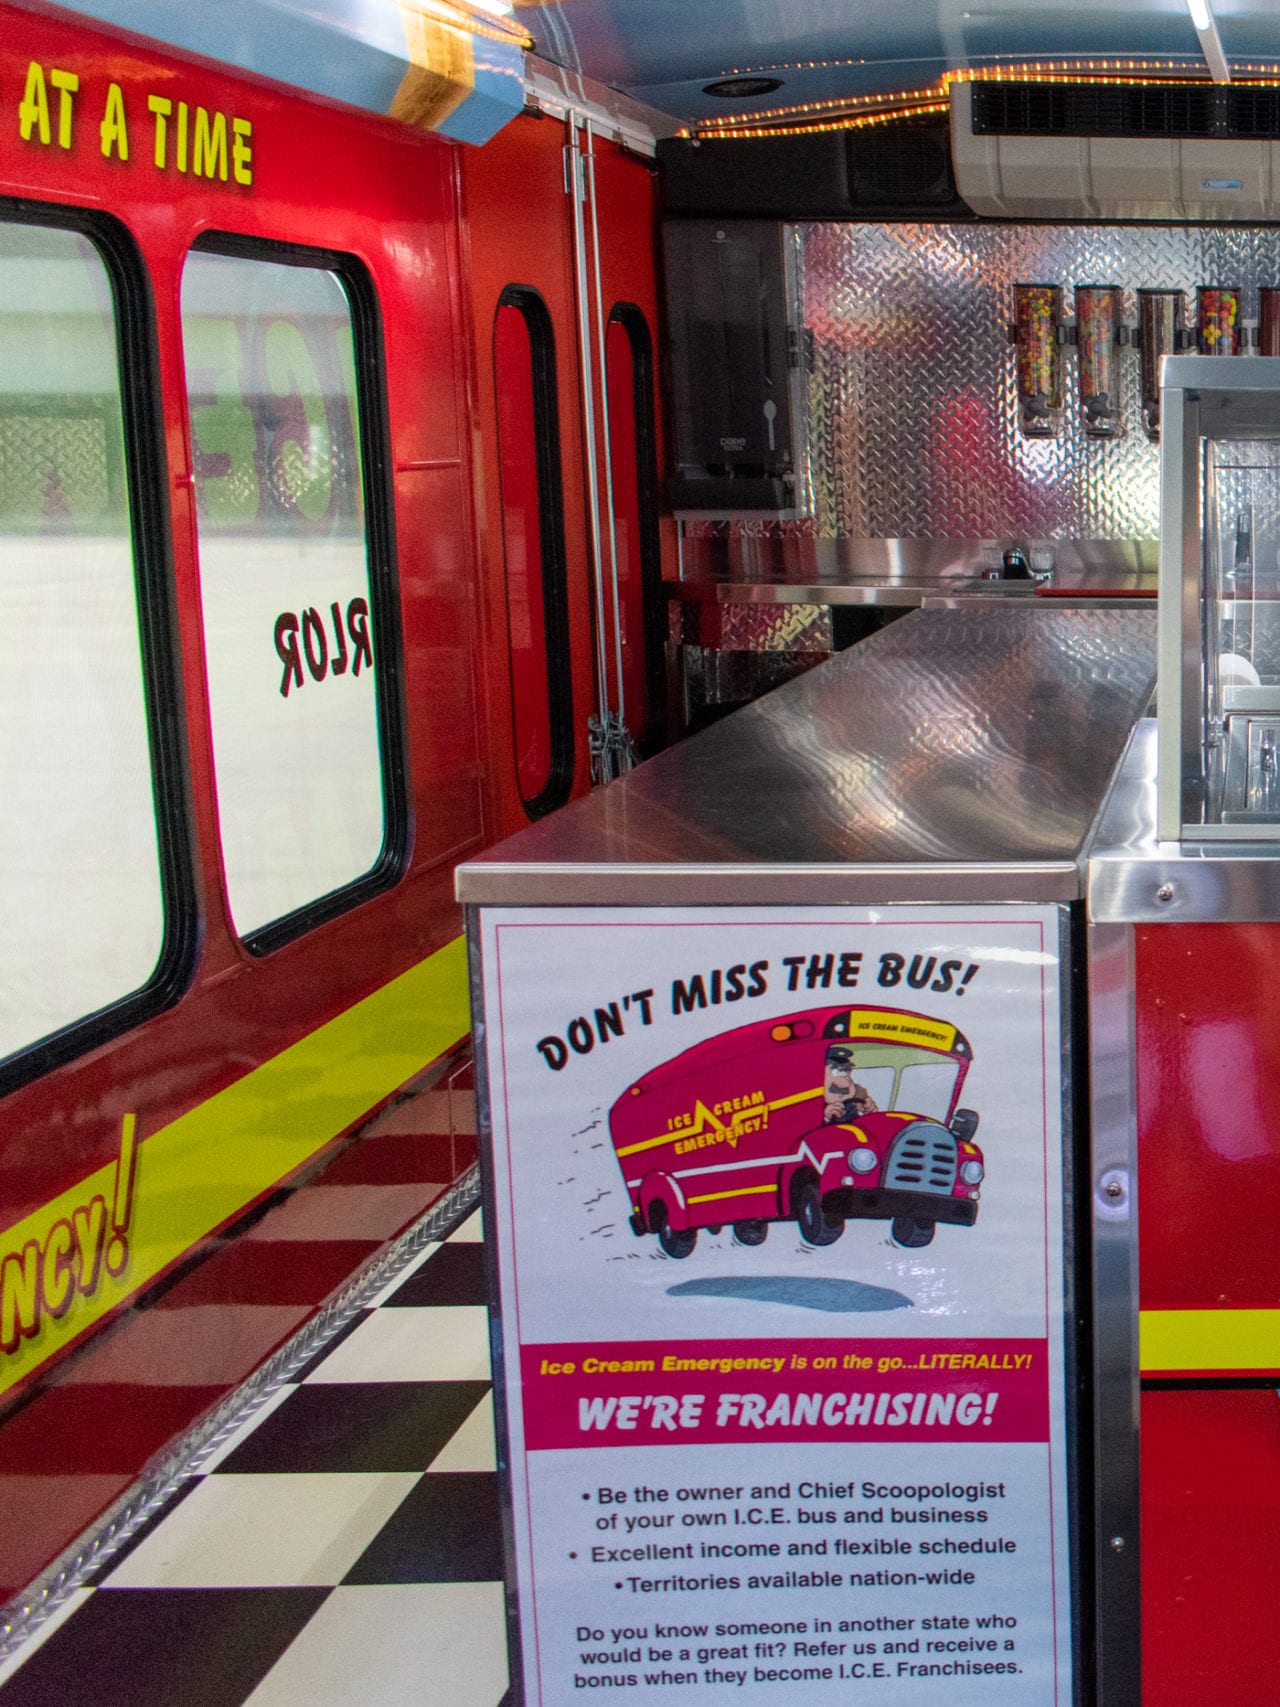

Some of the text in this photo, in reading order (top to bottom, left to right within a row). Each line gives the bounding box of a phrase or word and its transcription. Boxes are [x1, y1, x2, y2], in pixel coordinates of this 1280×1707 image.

[19, 60, 252, 185] AT A TIME
[536, 953, 980, 1071] DON'T MISS THE BUS!
[858, 1022, 871, 1030] ICE
[873, 1023, 898, 1032] CREAM
[667, 1090, 765, 1130] ICE CREAM
[674, 1103, 769, 1155] EMERGENCY!
[541, 1354, 1032, 1374] Ice Cream Emergency is on the go...LITERALLY!
[579, 1393, 998, 1430] WE'RE FRANCHISING!
[598, 1482, 1005, 1504] Be the owner and Chief Scoopologist
[596, 1507, 988, 1533] of your own I.C.E. bus and business
[592, 1538, 1016, 1562] Excellent income and flexible schedule
[627, 1569, 975, 1593] Territories available nation-wide
[577, 1614, 1017, 1643] Do you know someone in another state who
[580, 1637, 1014, 1664] would be a great fit? Refer us and receive a
[575, 1661, 1022, 1688] bonus when they become I.C.E. Franchisees.
